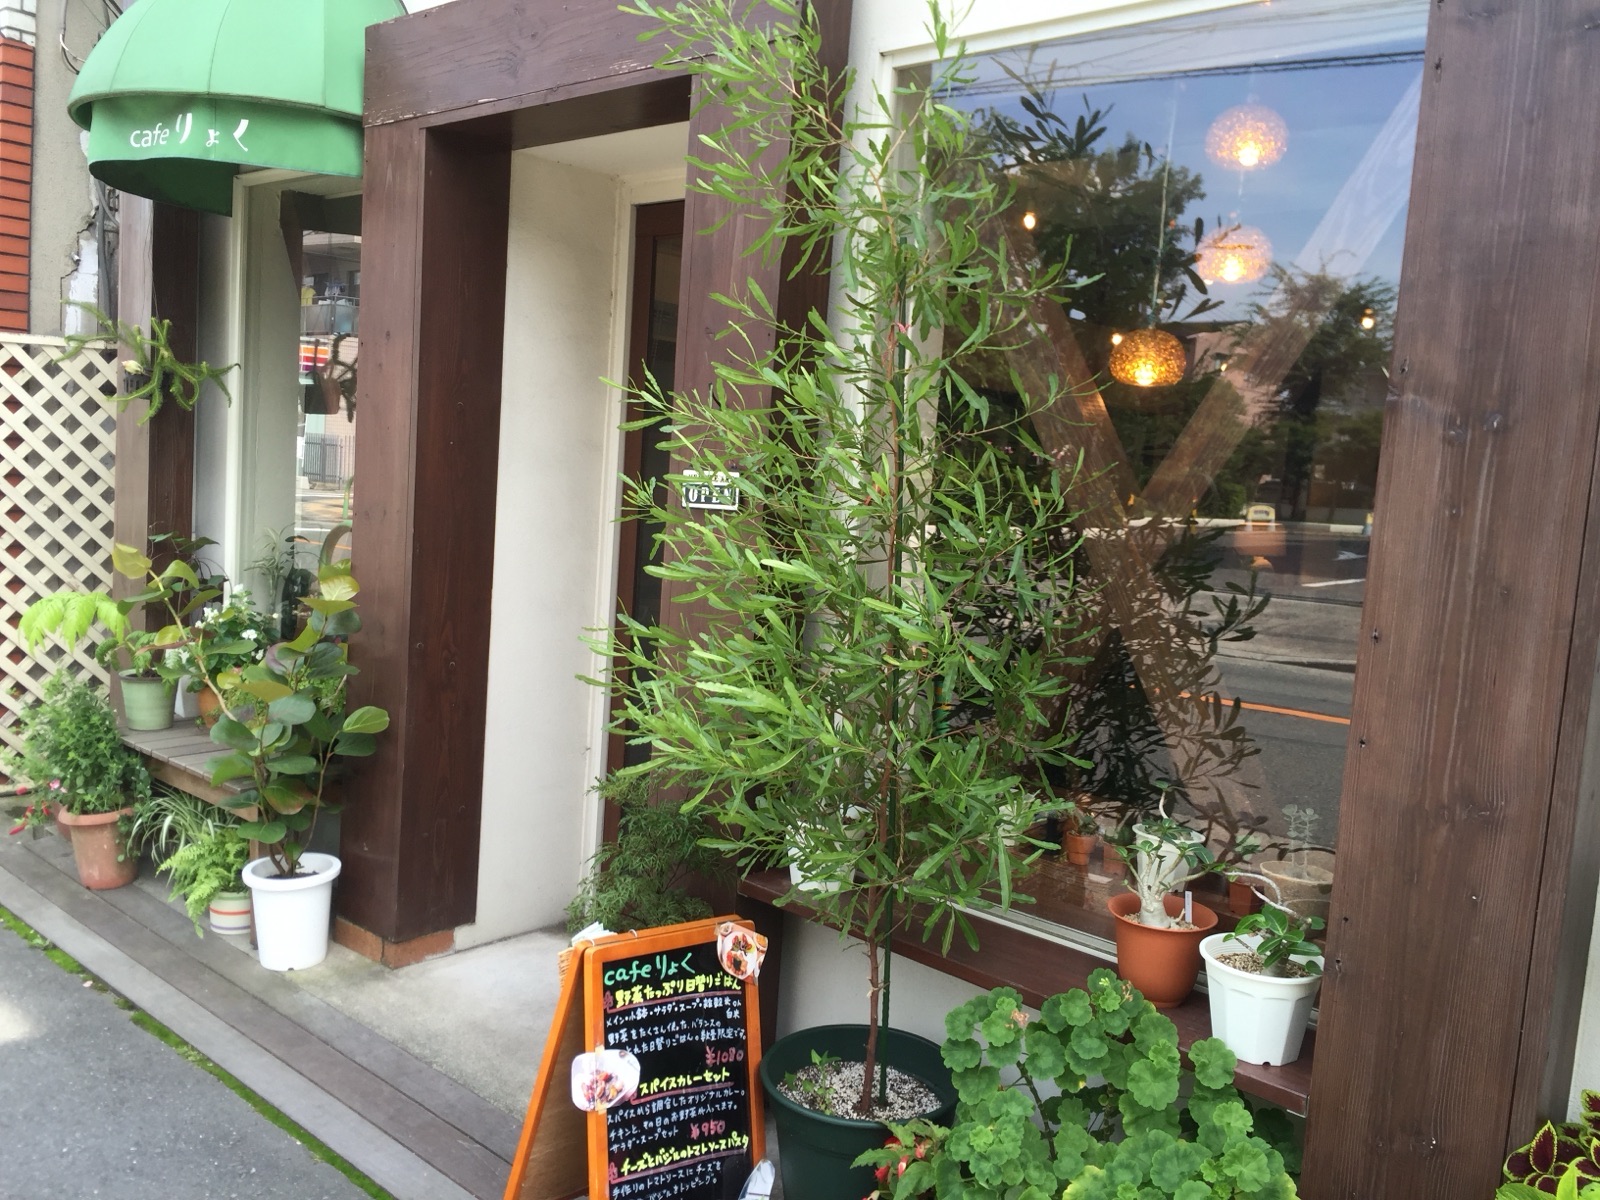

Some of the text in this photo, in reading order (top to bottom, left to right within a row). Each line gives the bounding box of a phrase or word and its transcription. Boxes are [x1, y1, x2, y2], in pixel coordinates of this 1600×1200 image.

[130, 112, 249, 152] cafe りょく
[604, 952, 695, 985] cafe りょく
[639, 1067, 730, 1096] スパイスカレーセット
[621, 1131, 749, 1176] チーズとバジルのトマトソースパスタ
